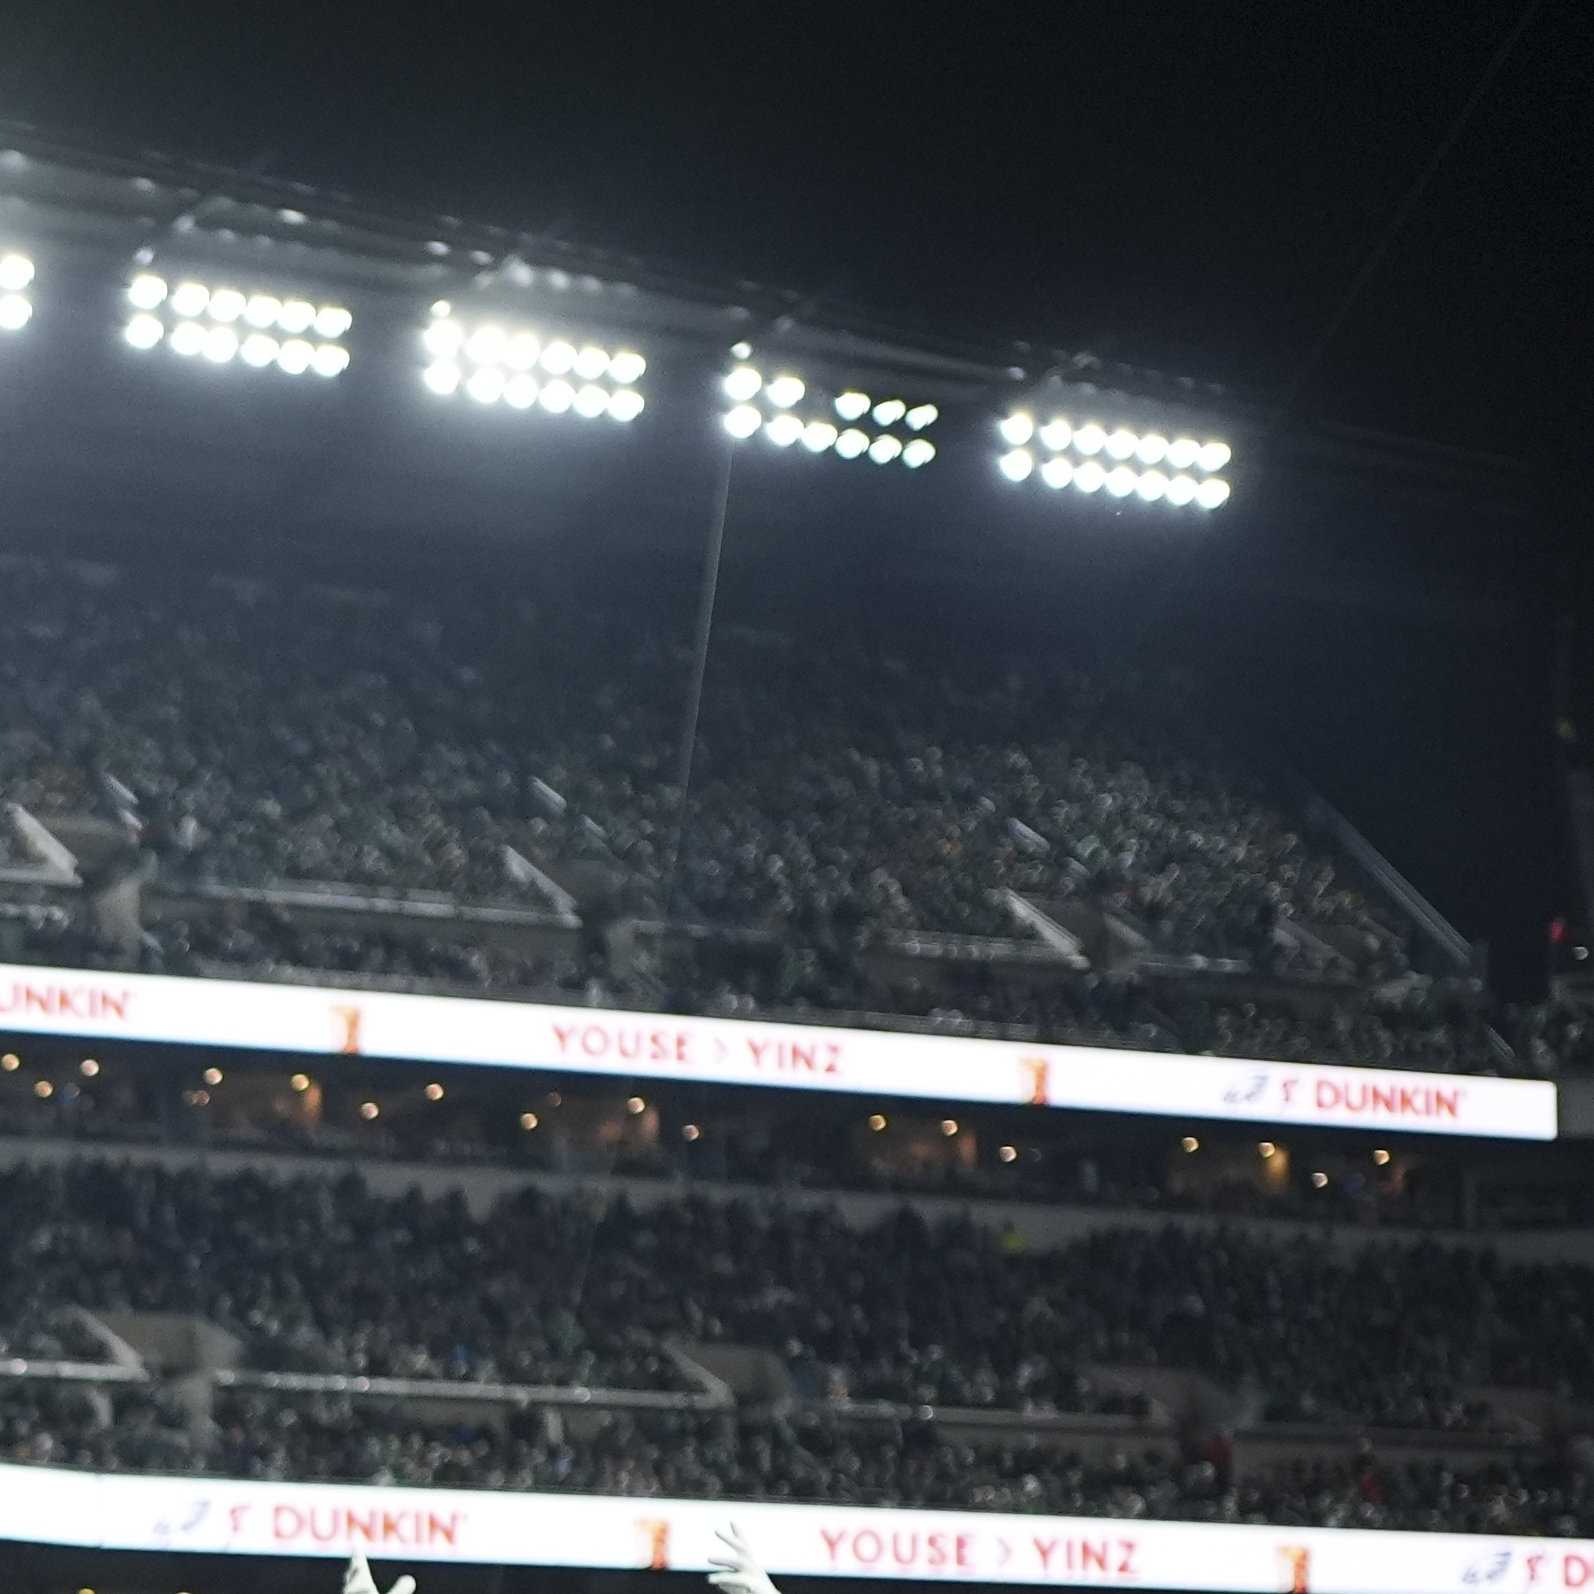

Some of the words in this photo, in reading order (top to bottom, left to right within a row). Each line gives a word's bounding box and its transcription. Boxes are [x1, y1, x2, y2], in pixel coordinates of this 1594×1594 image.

[551, 1022, 691, 1065] YOUSE
[747, 1037, 845, 1075] YINZ
[820, 1527, 974, 1567] YOUSE
[1032, 1538, 1139, 1574] YINZ
